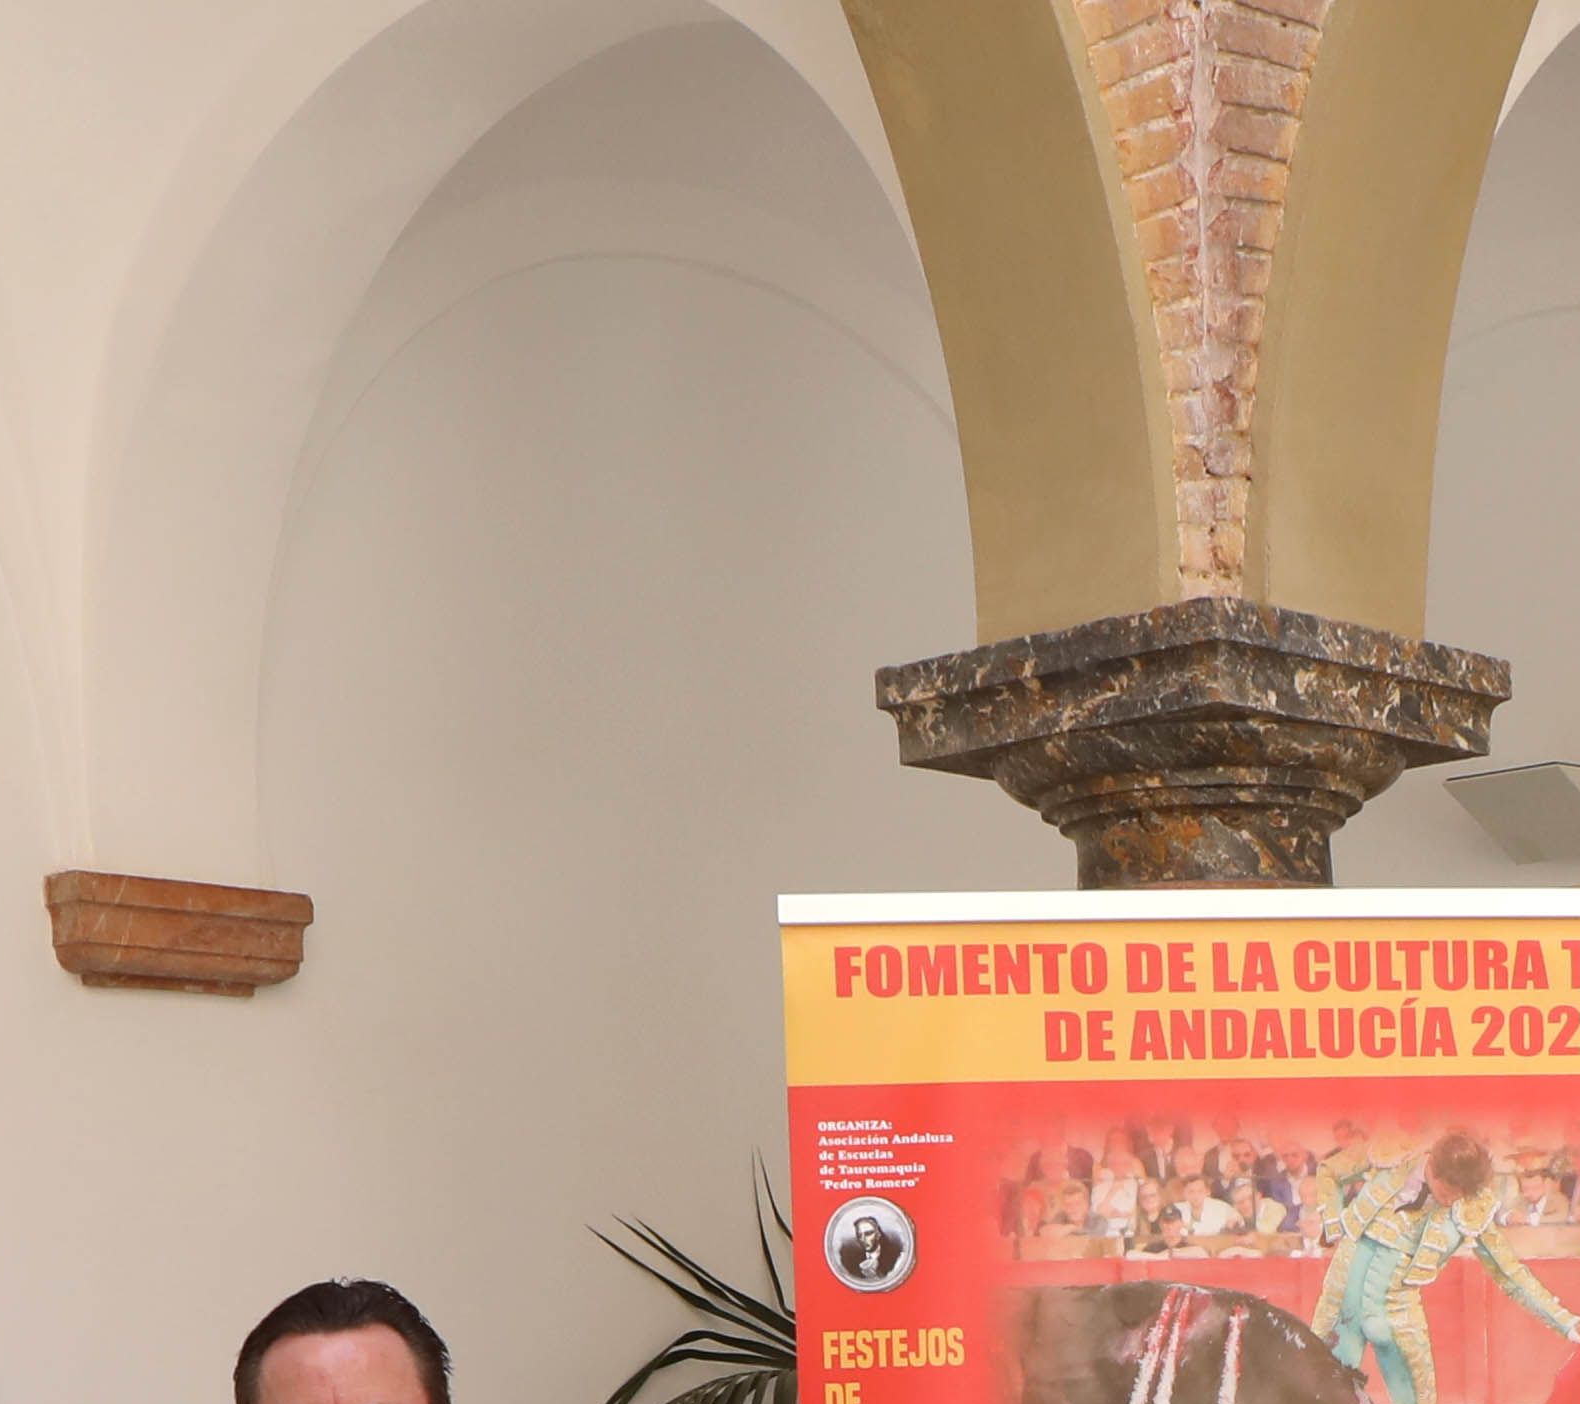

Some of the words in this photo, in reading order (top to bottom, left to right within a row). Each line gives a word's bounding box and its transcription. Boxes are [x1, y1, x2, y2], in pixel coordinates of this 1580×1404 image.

[834, 942, 1108, 998] FOMENTO
[1125, 942, 1196, 993] DE
[1212, 941, 1279, 992] LA
[1293, 940, 1549, 992] CULTURA
[1044, 1010, 1116, 1062] DE
[1129, 997, 1458, 1061] ANDALUCÍA
[818, 1120, 892, 1131] ORGANIZA:
[818, 1135, 888, 1146] Asociación
[892, 1133, 953, 1144] Andaluza
[819, 1150, 834, 1161] de
[838, 1149, 893, 1160] Escuelas
[820, 1165, 835, 1175] de
[838, 1162, 926, 1175] Tauromaquia
[823, 1327, 965, 1369] FESTEJOS
